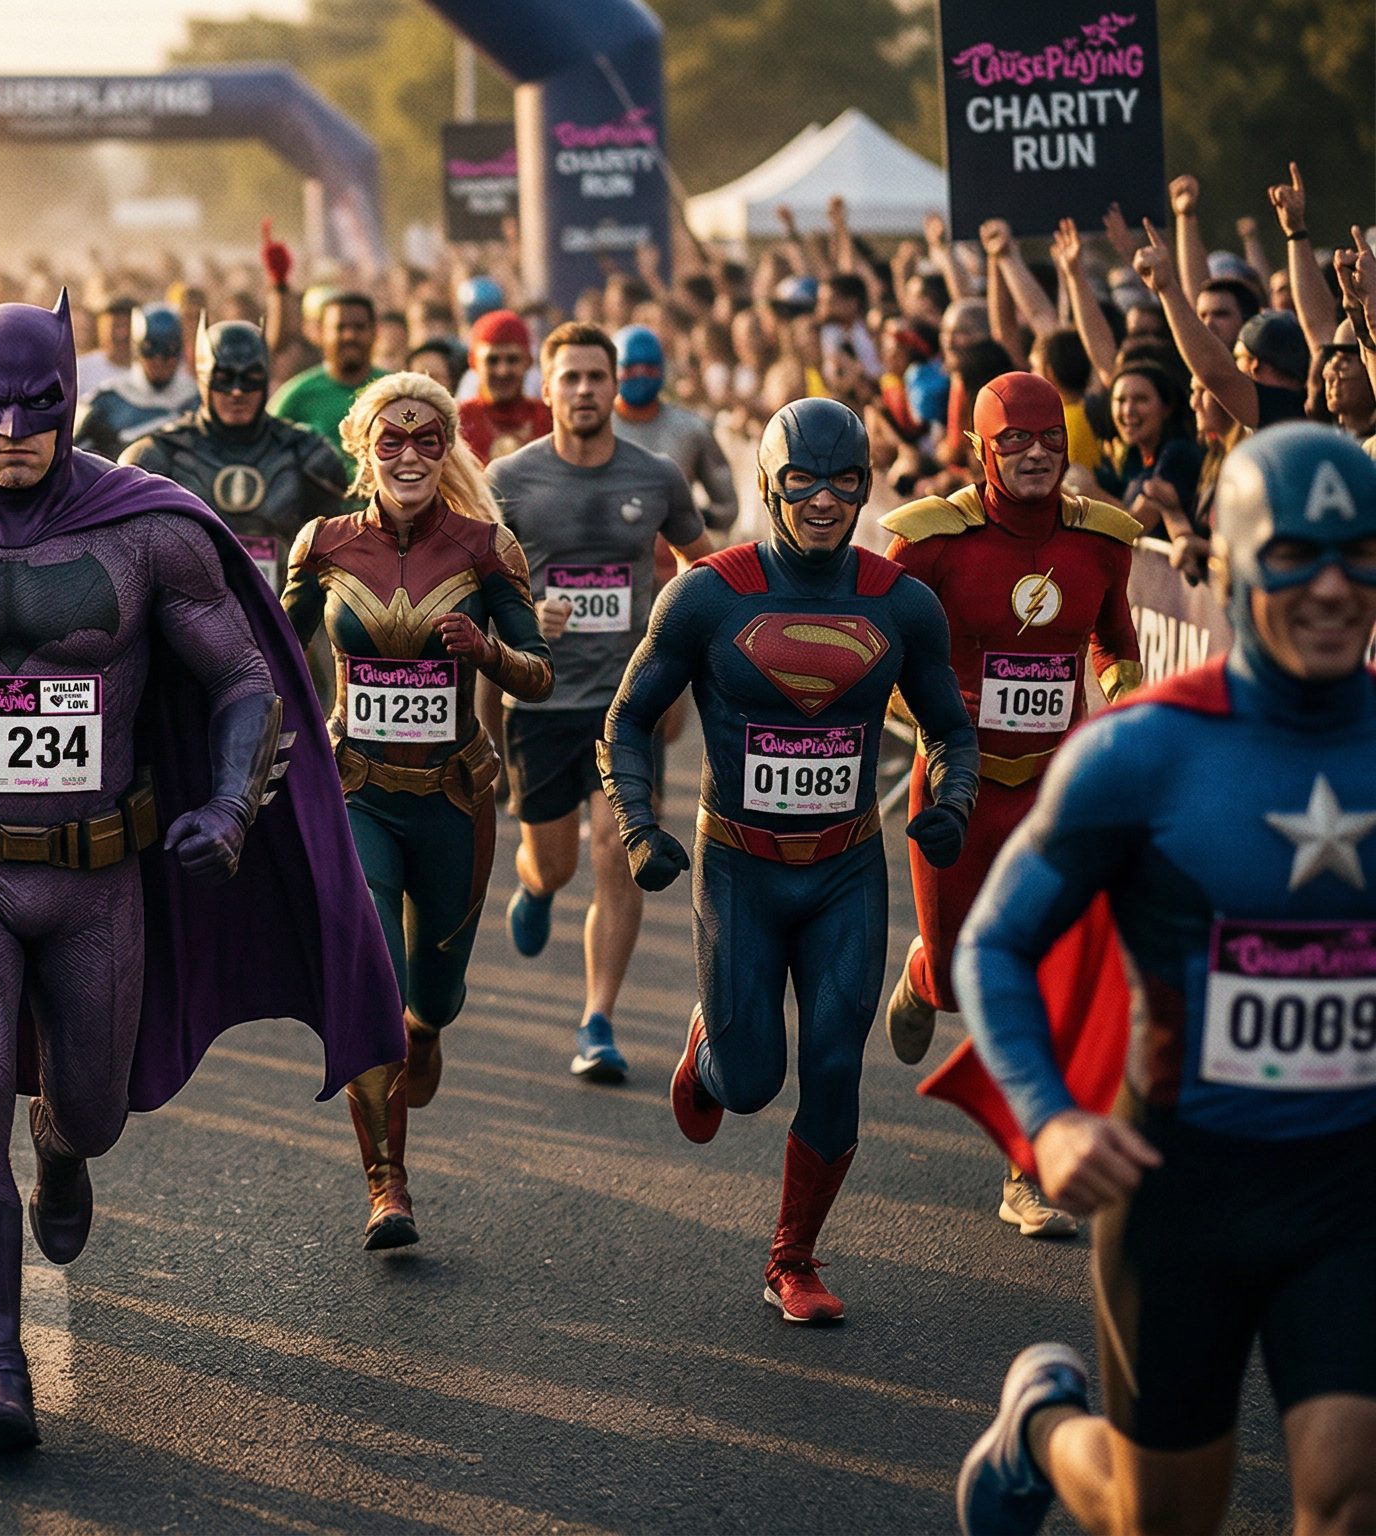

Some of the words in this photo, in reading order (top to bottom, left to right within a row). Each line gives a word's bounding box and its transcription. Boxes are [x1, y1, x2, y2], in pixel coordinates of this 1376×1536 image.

[966, 88, 1139, 133] CHARITY
[1013, 133, 1096, 172] RUN
[1305, 460, 1357, 521] A
[558, 594, 620, 618] 308
[52, 682, 90, 693] VILLAIN
[997, 687, 1064, 716] 1096
[355, 692, 448, 724] 01233
[754, 763, 851, 797] 01983
[1230, 992, 1376, 1055] 0089
